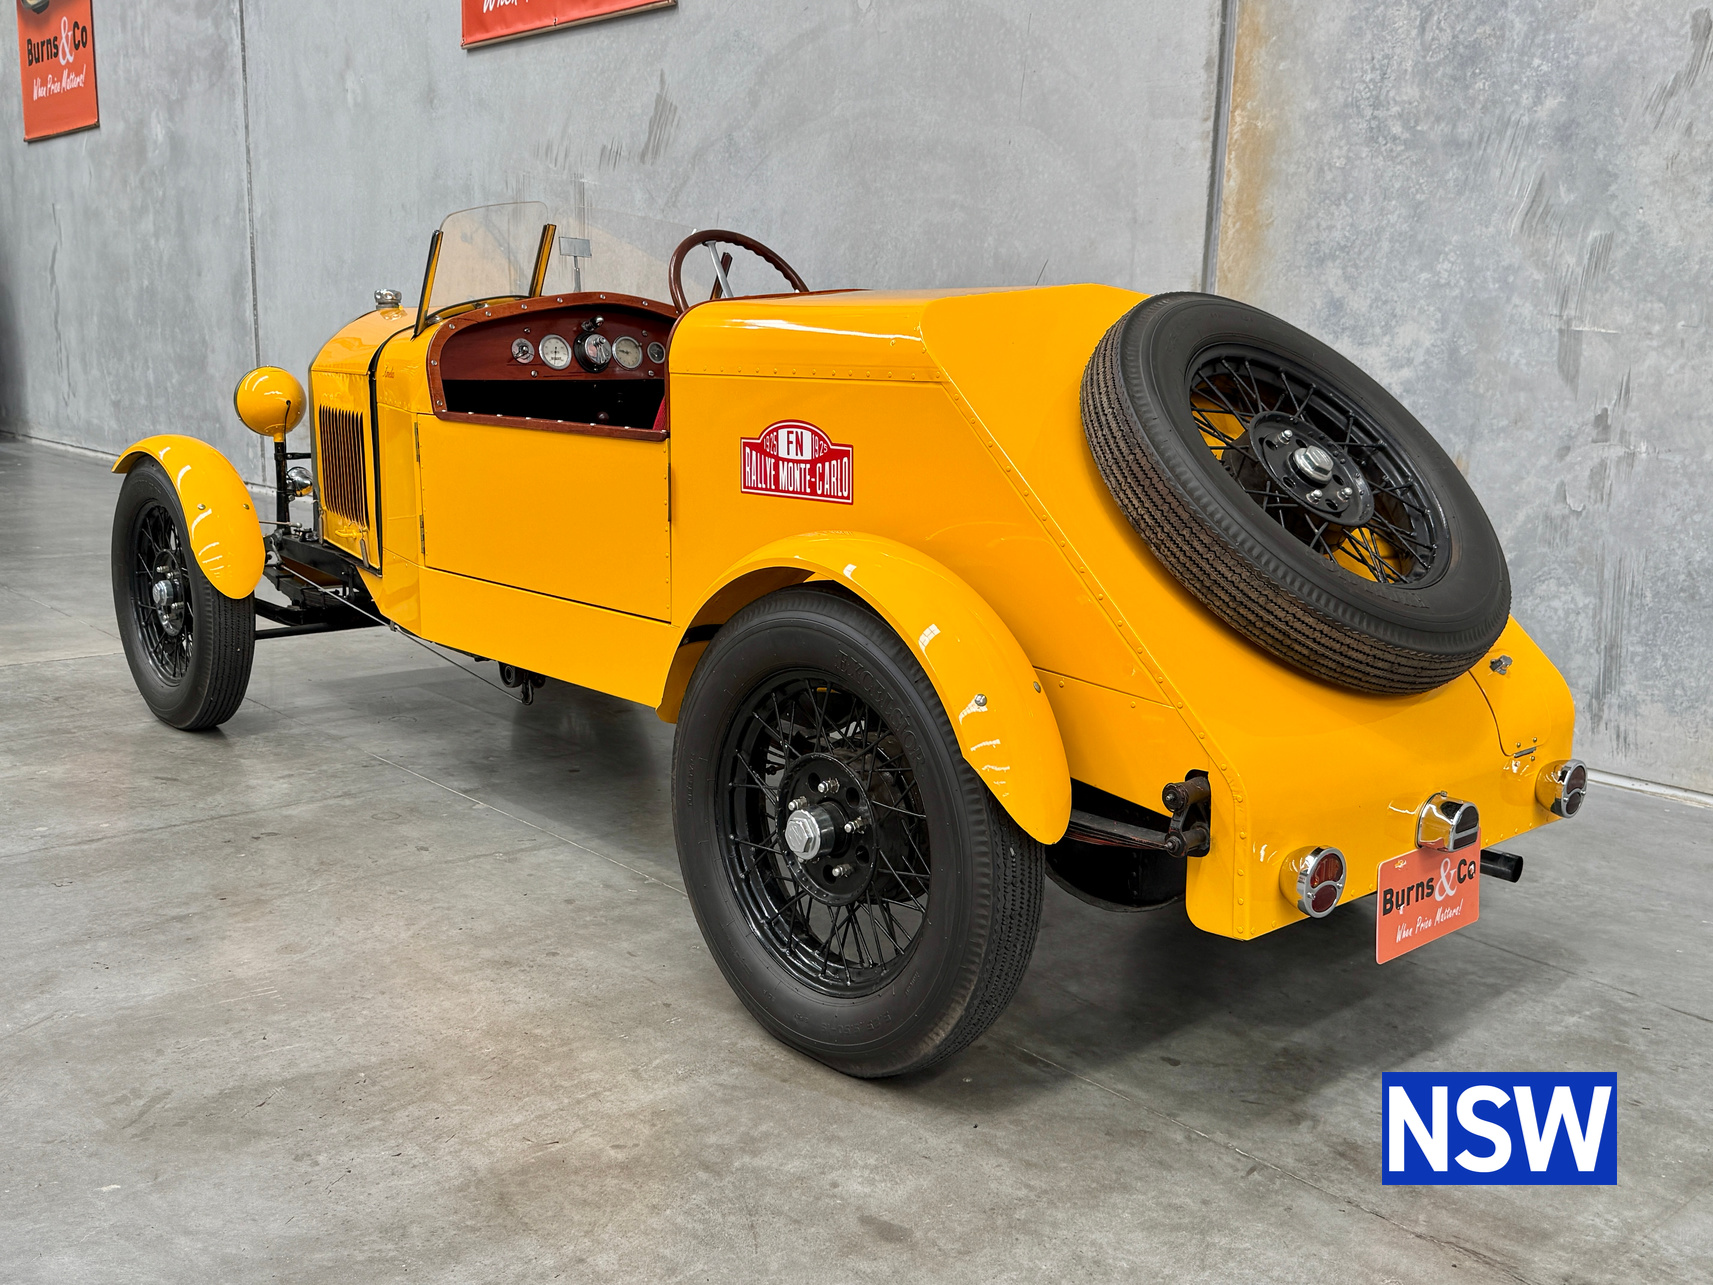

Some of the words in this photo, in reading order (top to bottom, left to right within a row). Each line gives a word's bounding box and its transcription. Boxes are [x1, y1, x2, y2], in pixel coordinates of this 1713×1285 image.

[47, 74, 60, 97] Price
[763, 432, 777, 455] 1925
[787, 430, 804, 457] FN
[812, 434, 828, 459] 1925
[745, 446, 775, 489] RALLYE
[1415, 916, 1432, 934] Price
